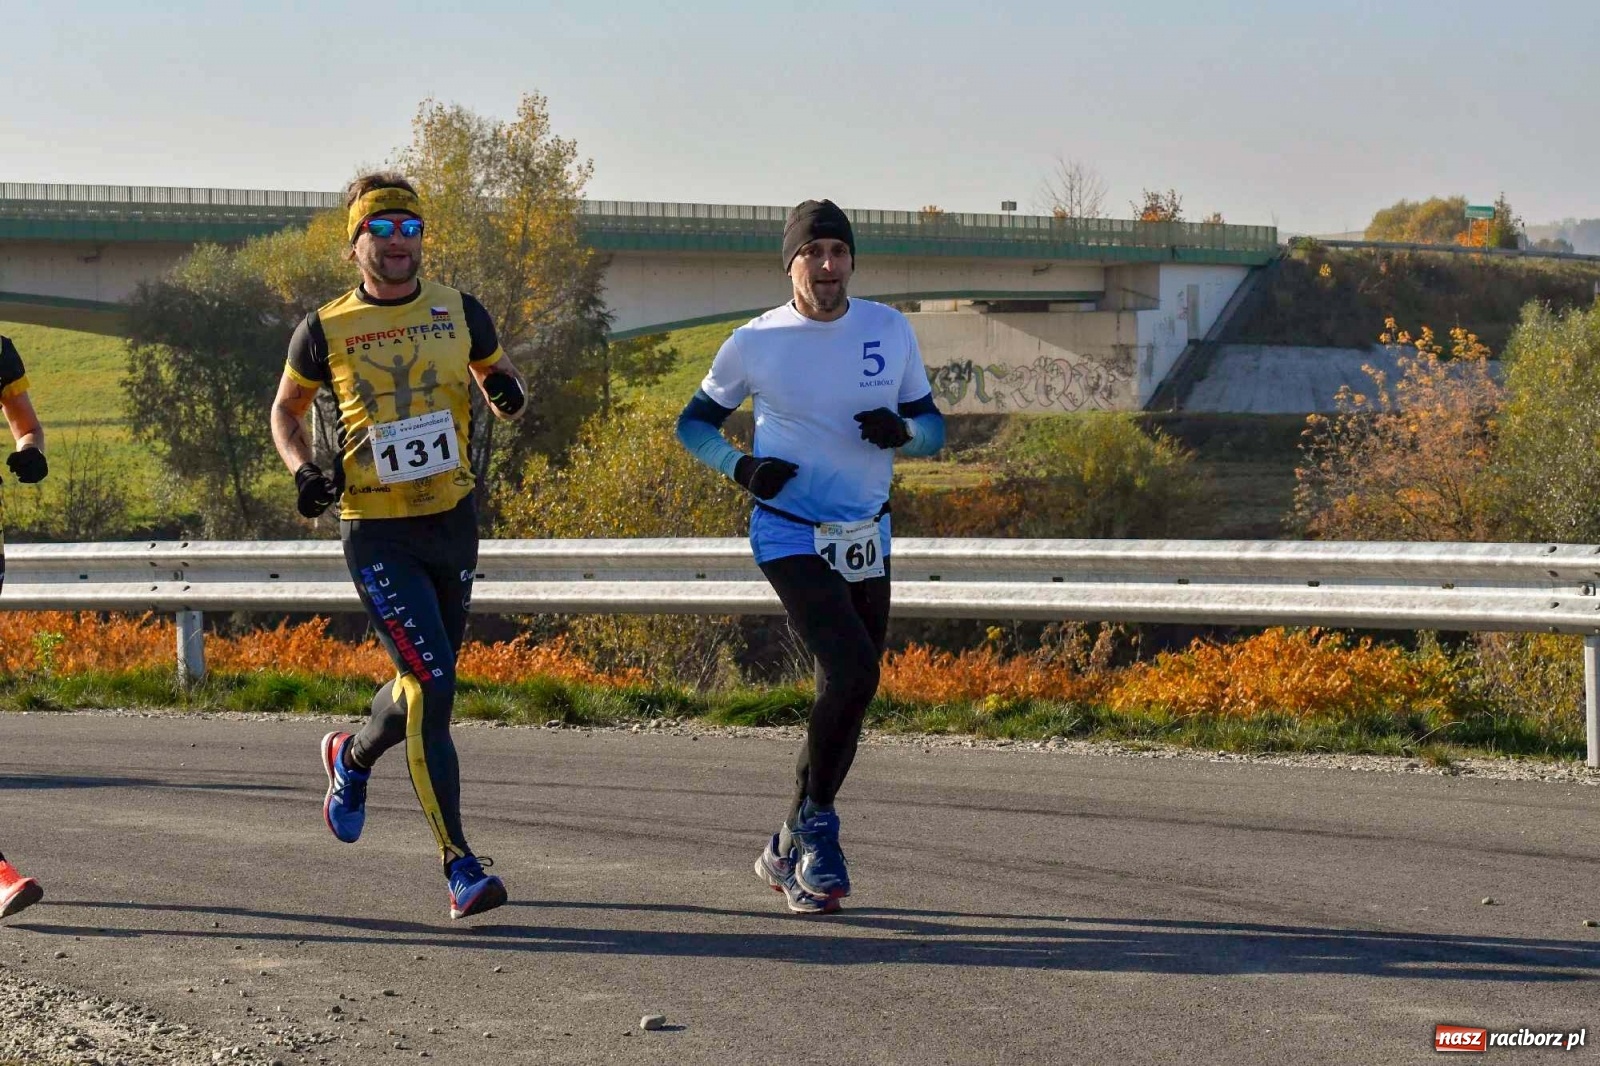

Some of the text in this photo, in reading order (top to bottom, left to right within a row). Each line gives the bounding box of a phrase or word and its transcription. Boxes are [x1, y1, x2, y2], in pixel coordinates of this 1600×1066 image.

[346, 331, 456, 355] BOLATICE
[862, 341, 885, 377] 5
[380, 433, 451, 472] 131
[820, 539, 877, 571] 160
[373, 562, 443, 677] BOLATICE
